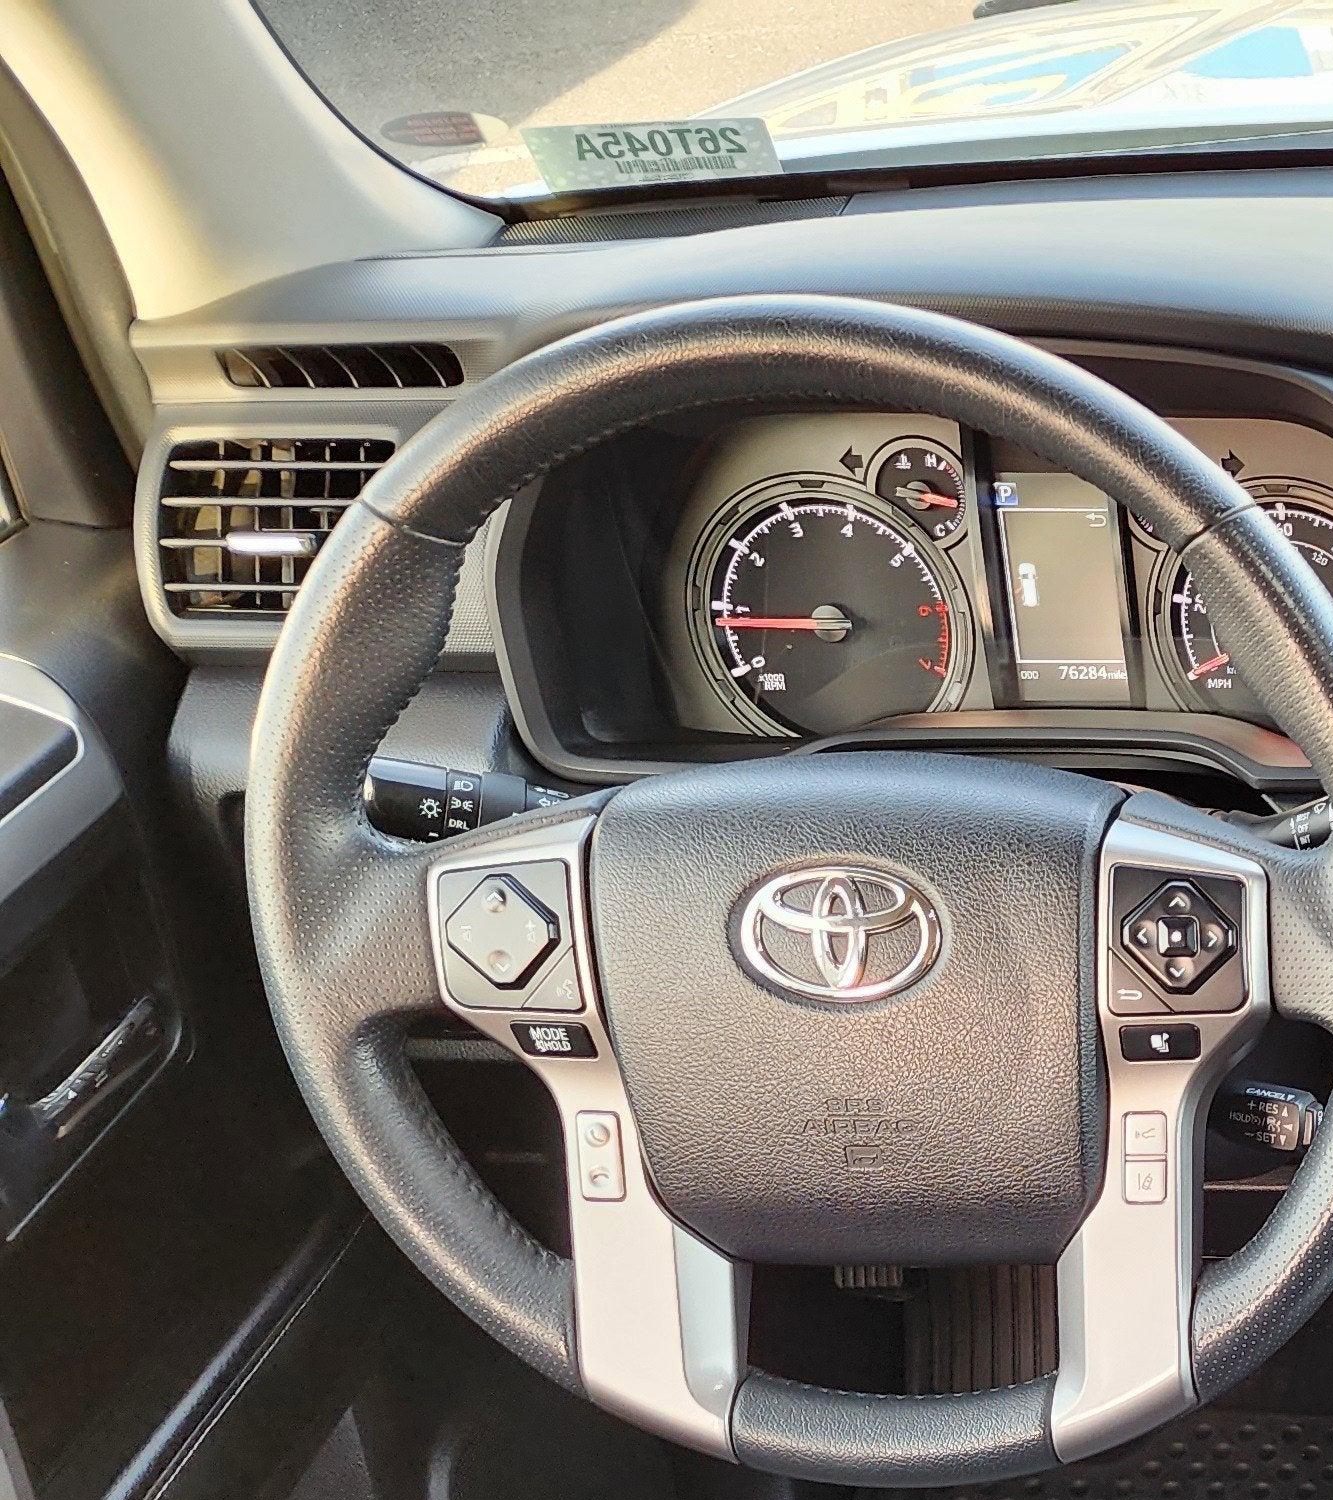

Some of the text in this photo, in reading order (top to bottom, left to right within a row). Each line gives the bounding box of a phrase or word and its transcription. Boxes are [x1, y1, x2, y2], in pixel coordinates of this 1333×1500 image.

[924, 454, 937, 467] H
[999, 484, 1012, 503] P
[791, 523, 804, 537] 3
[840, 523, 853, 538] 4
[934, 523, 946, 537] C
[749, 552, 765, 568] 2
[890, 552, 905, 568] 5
[751, 655, 766, 668] 0
[1058, 666, 1107, 680] 76284
[764, 681, 786, 691] RPM
[1207, 678, 1232, 689] MPH
[449, 818, 470, 831] DRL
[529, 1026, 570, 1041] MODE
[1246, 1087, 1287, 1099] CANCEL
[801, 1119, 917, 1136] AIRBAG
